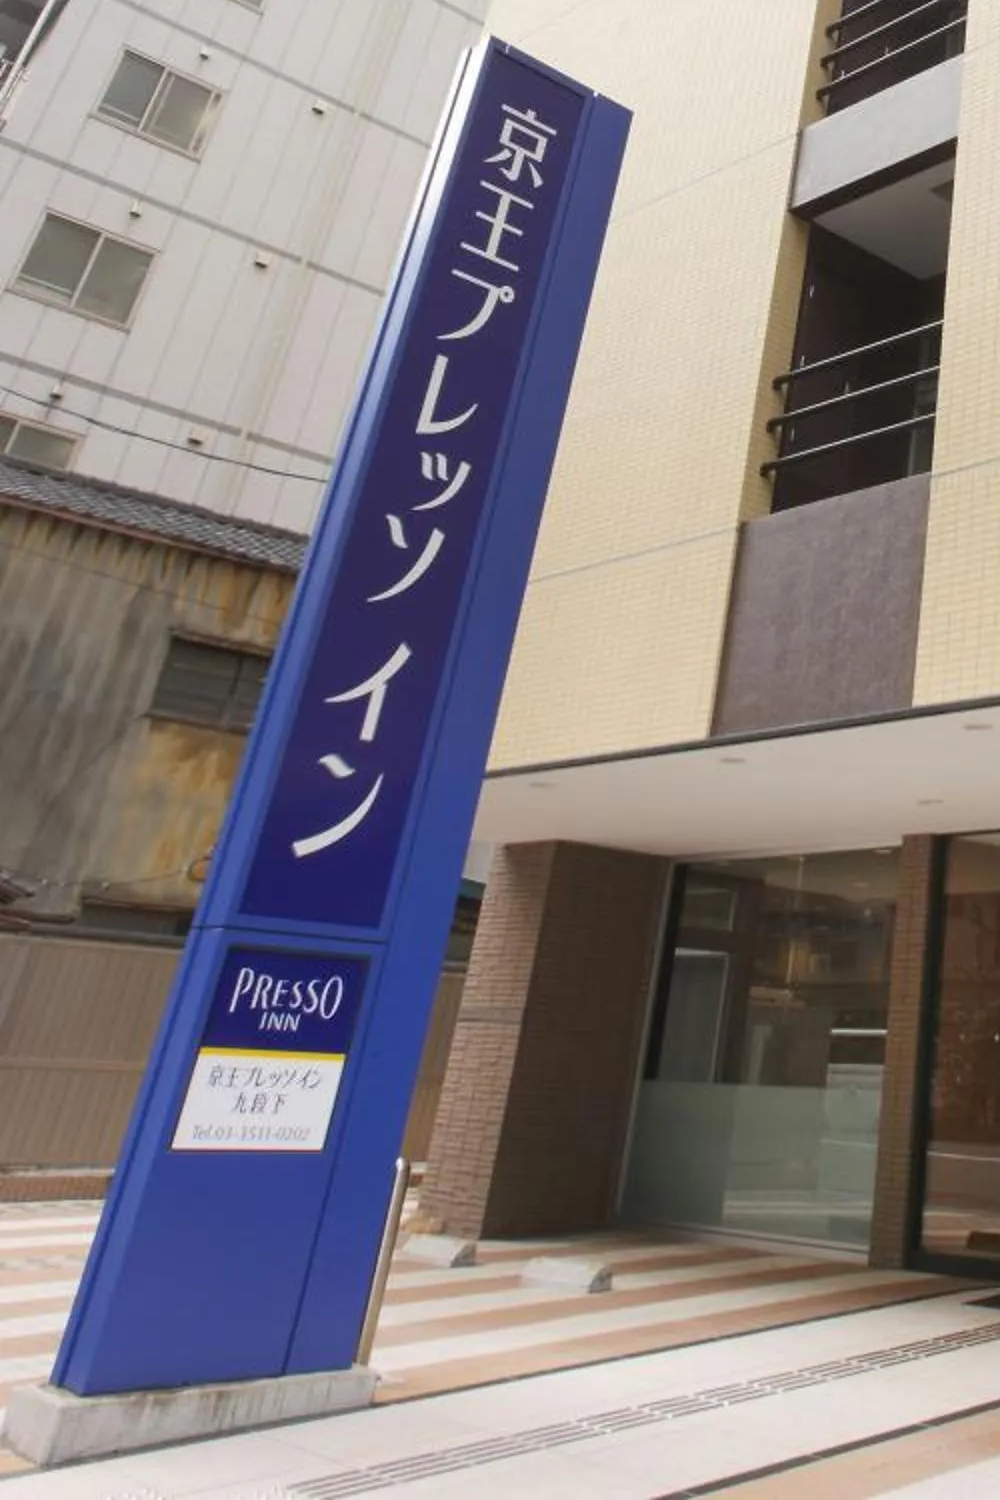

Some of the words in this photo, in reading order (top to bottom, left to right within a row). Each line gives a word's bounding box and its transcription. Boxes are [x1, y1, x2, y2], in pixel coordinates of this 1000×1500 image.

[292, 103, 557, 858] 京王プレッソイン
[229, 967, 343, 1020] PRESSO
[259, 1011, 301, 1032] INN
[231, 1091, 289, 1115] 九段下
